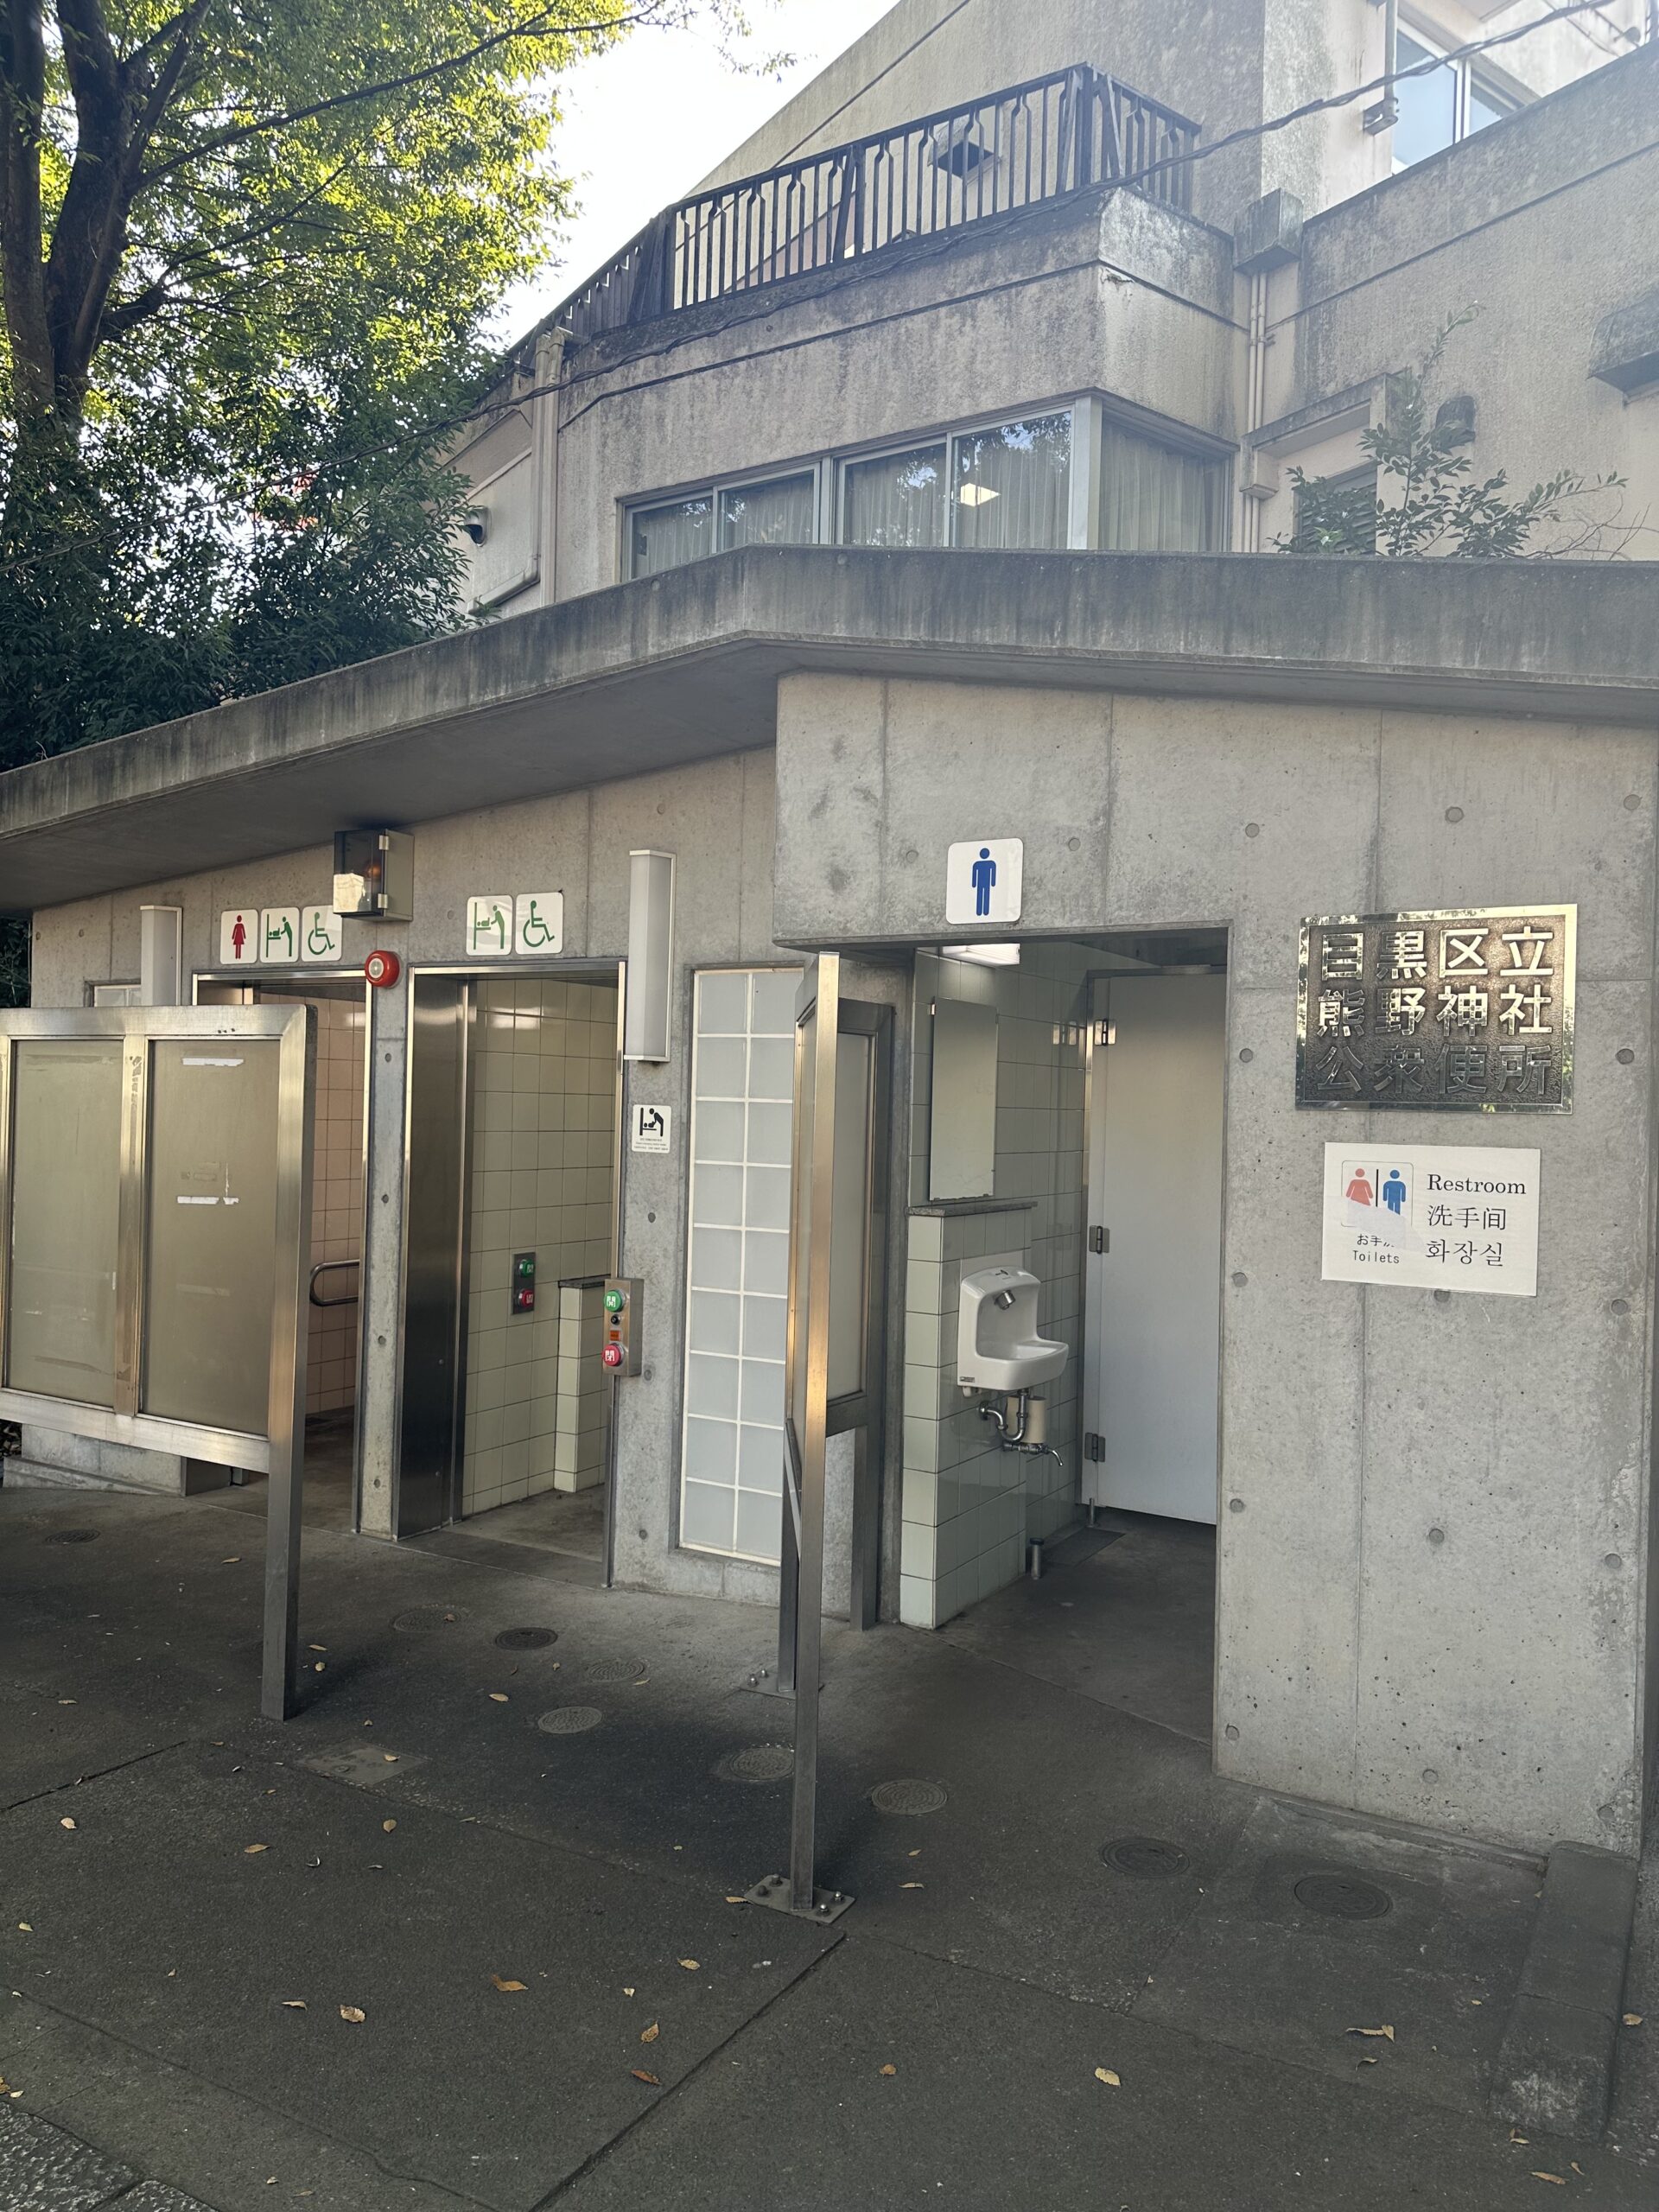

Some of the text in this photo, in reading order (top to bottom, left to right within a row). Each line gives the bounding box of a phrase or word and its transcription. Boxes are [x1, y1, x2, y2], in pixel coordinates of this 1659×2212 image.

[1321, 925, 1554, 982] 目黒区立
[1316, 984, 1553, 1038] 熊野神社
[1315, 1043, 1552, 1096] 公衆便所
[1427, 1173, 1527, 1195] Restroom
[1427, 1204, 1506, 1230] 洗手间
[1352, 1249, 1400, 1264] Toilets
[1425, 1238, 1503, 1267] 화장실
